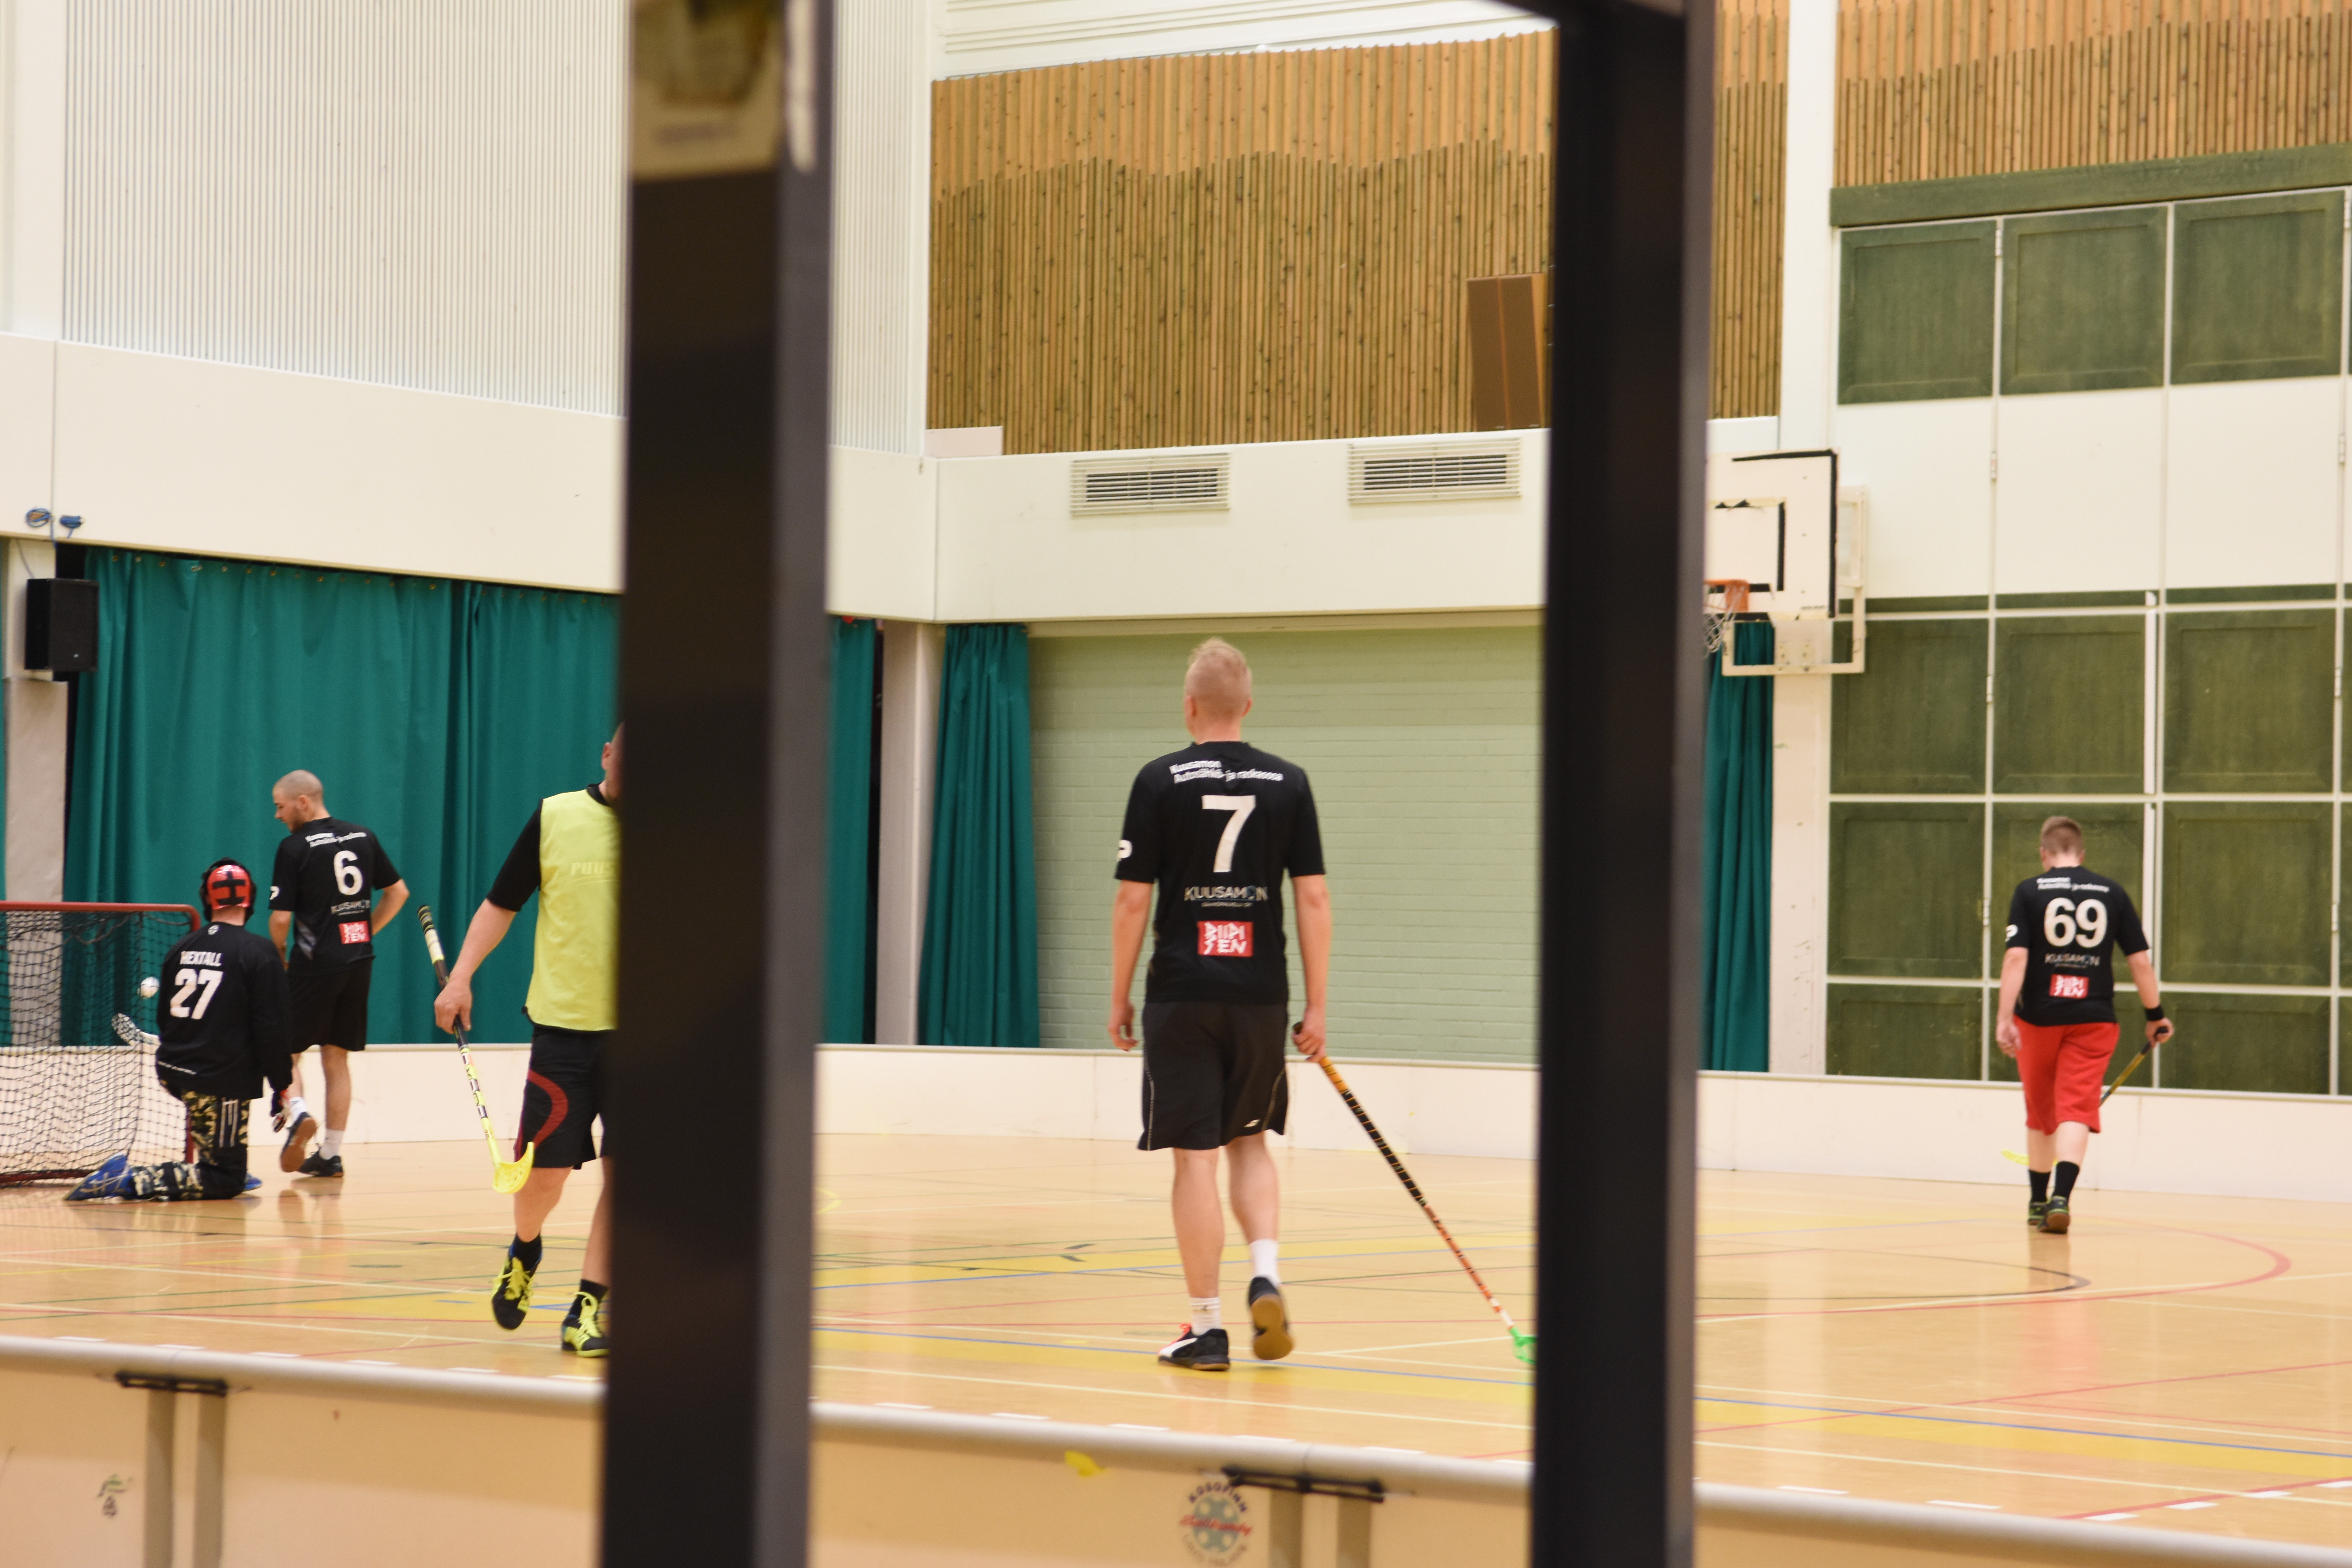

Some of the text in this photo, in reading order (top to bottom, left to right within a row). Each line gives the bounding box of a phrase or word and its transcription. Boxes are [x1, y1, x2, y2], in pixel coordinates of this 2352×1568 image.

[1201, 795, 1256, 873] 7
[334, 850, 363, 895] 6
[1184, 886, 1268, 901] KUUSAMON
[2044, 897, 2107, 948] 69
[170, 968, 224, 1020] 27
